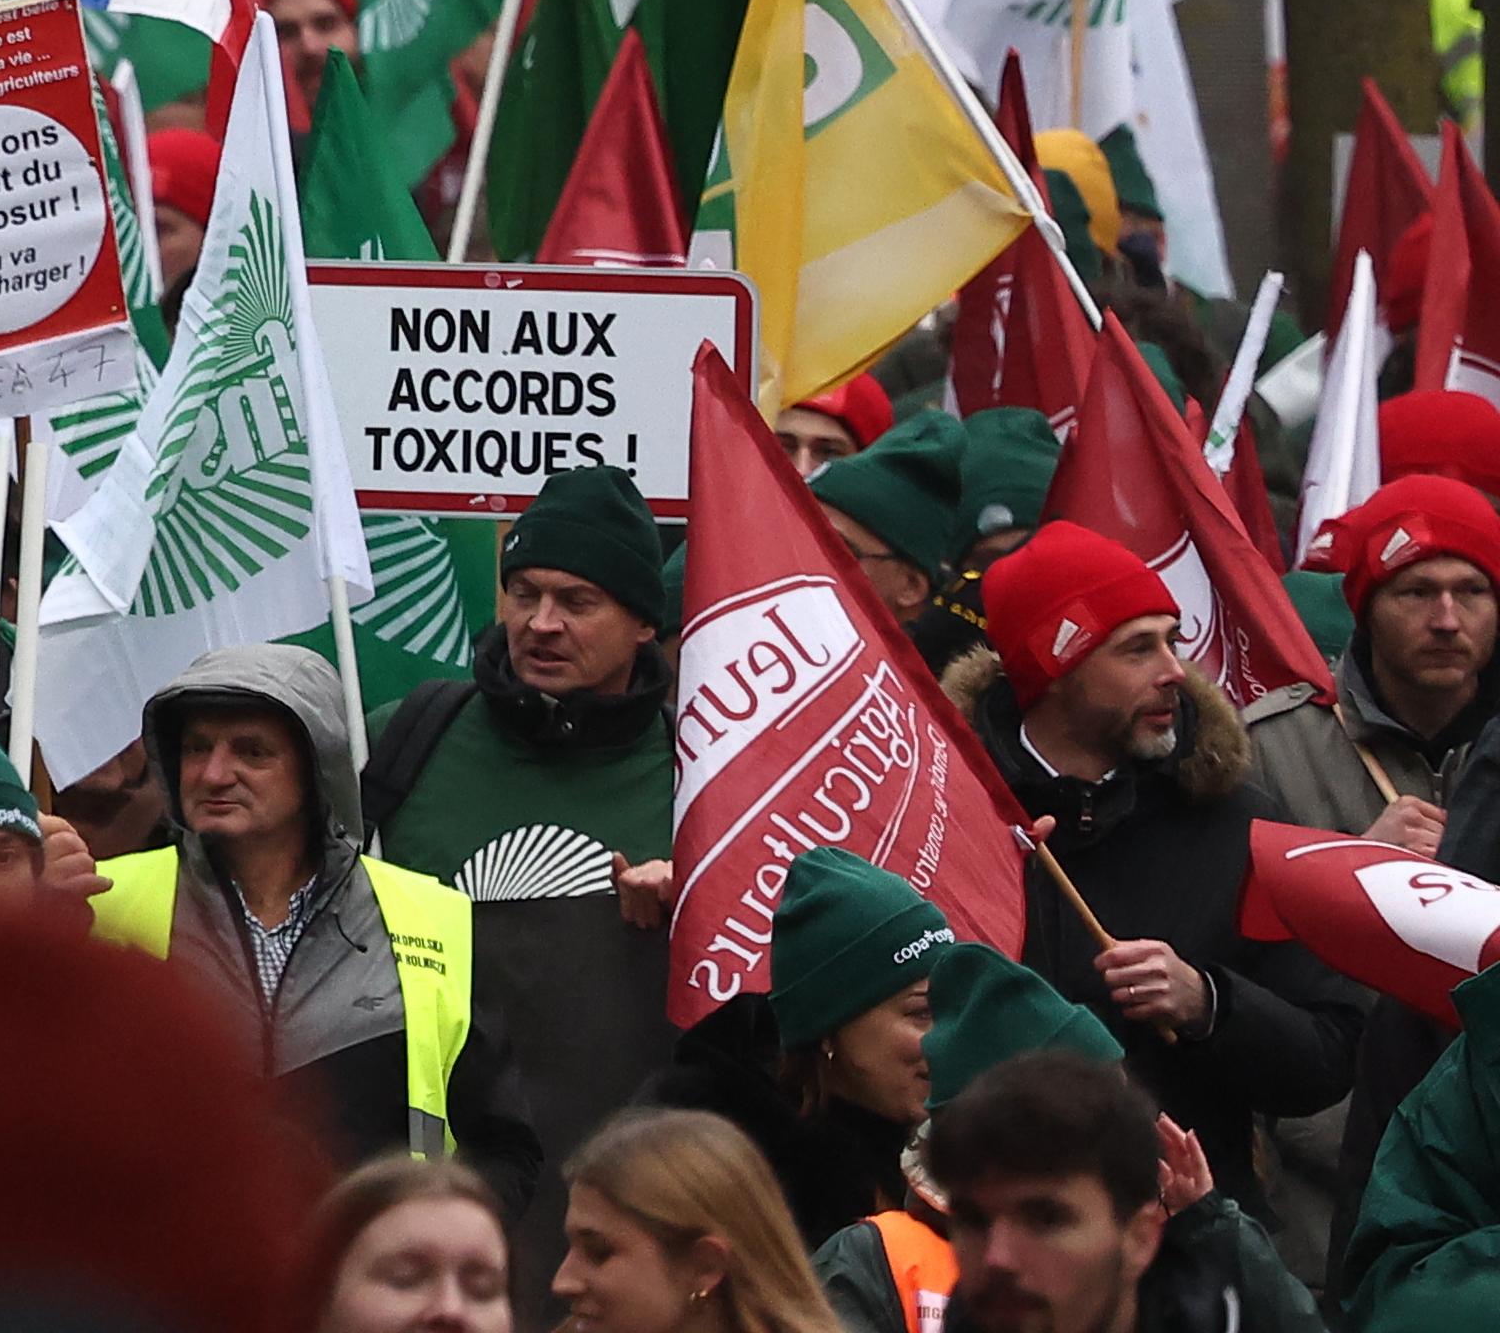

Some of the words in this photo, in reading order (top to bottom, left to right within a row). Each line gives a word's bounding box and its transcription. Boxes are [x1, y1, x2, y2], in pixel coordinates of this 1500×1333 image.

[7, 27, 33, 45] est
[9, 49, 33, 68] vie
[22, 158, 62, 187] du
[71, 185, 81, 212] !
[10, 246, 37, 265] va
[79, 255, 86, 277] !
[390, 306, 490, 353] NON
[511, 310, 617, 358] AUX
[388, 367, 617, 418] ACCORDS
[364, 426, 605, 478] TOXIQUES
[627, 433, 638, 478] !
